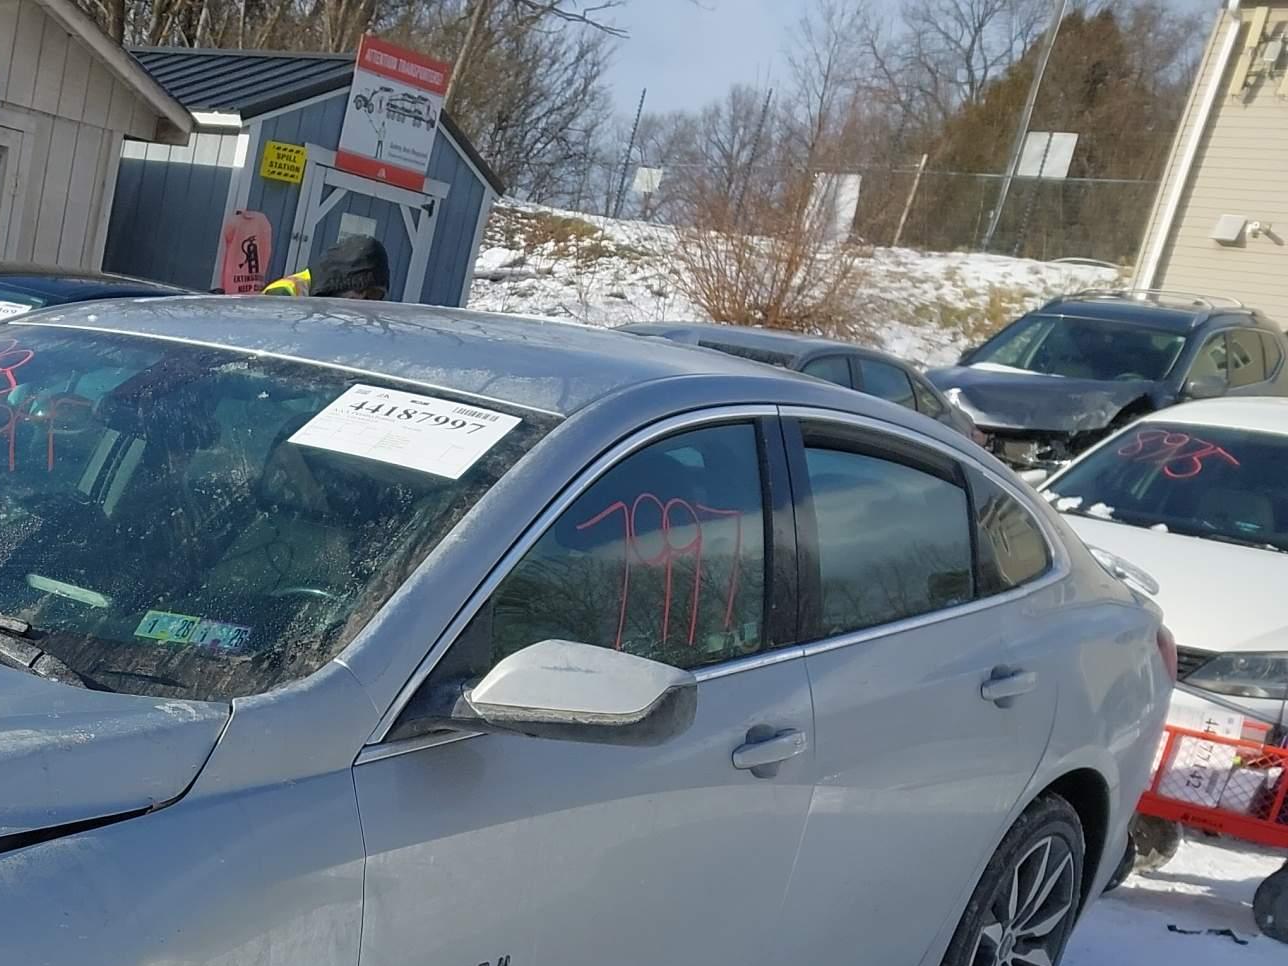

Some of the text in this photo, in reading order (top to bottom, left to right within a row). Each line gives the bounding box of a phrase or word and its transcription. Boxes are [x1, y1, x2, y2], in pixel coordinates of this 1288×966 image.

[269, 161, 301, 173] STATION
[277, 152, 297, 163] SPILL
[349, 400, 487, 435] 44187997
[575, 493, 745, 651] 7997
